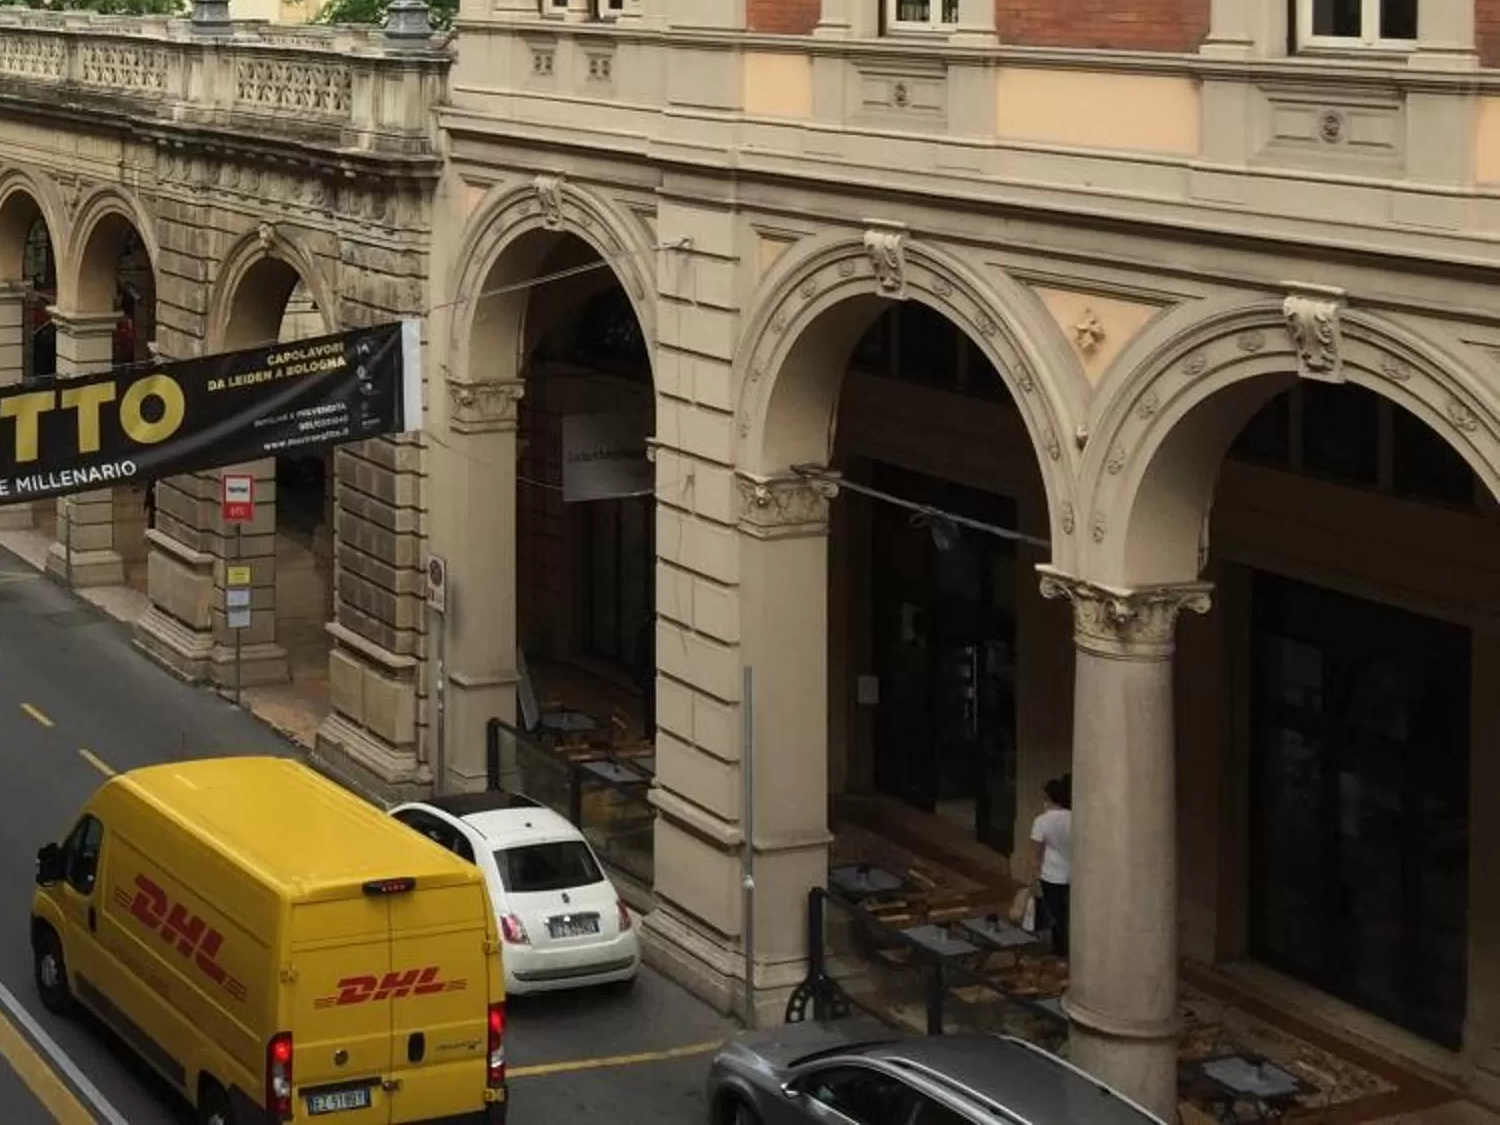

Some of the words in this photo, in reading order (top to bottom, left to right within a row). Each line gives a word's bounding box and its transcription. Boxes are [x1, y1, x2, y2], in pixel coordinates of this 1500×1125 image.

[267, 342, 345, 366] CAPOLAVORI
[207, 378, 226, 392] DA
[228, 369, 273, 388] LEIDEN
[275, 369, 284, 379] A
[286, 356, 347, 377] BOLOGNA
[16, 460, 137, 493] MILLENARIO
[130, 874, 228, 986] DHL
[336, 965, 445, 1006] DHL
